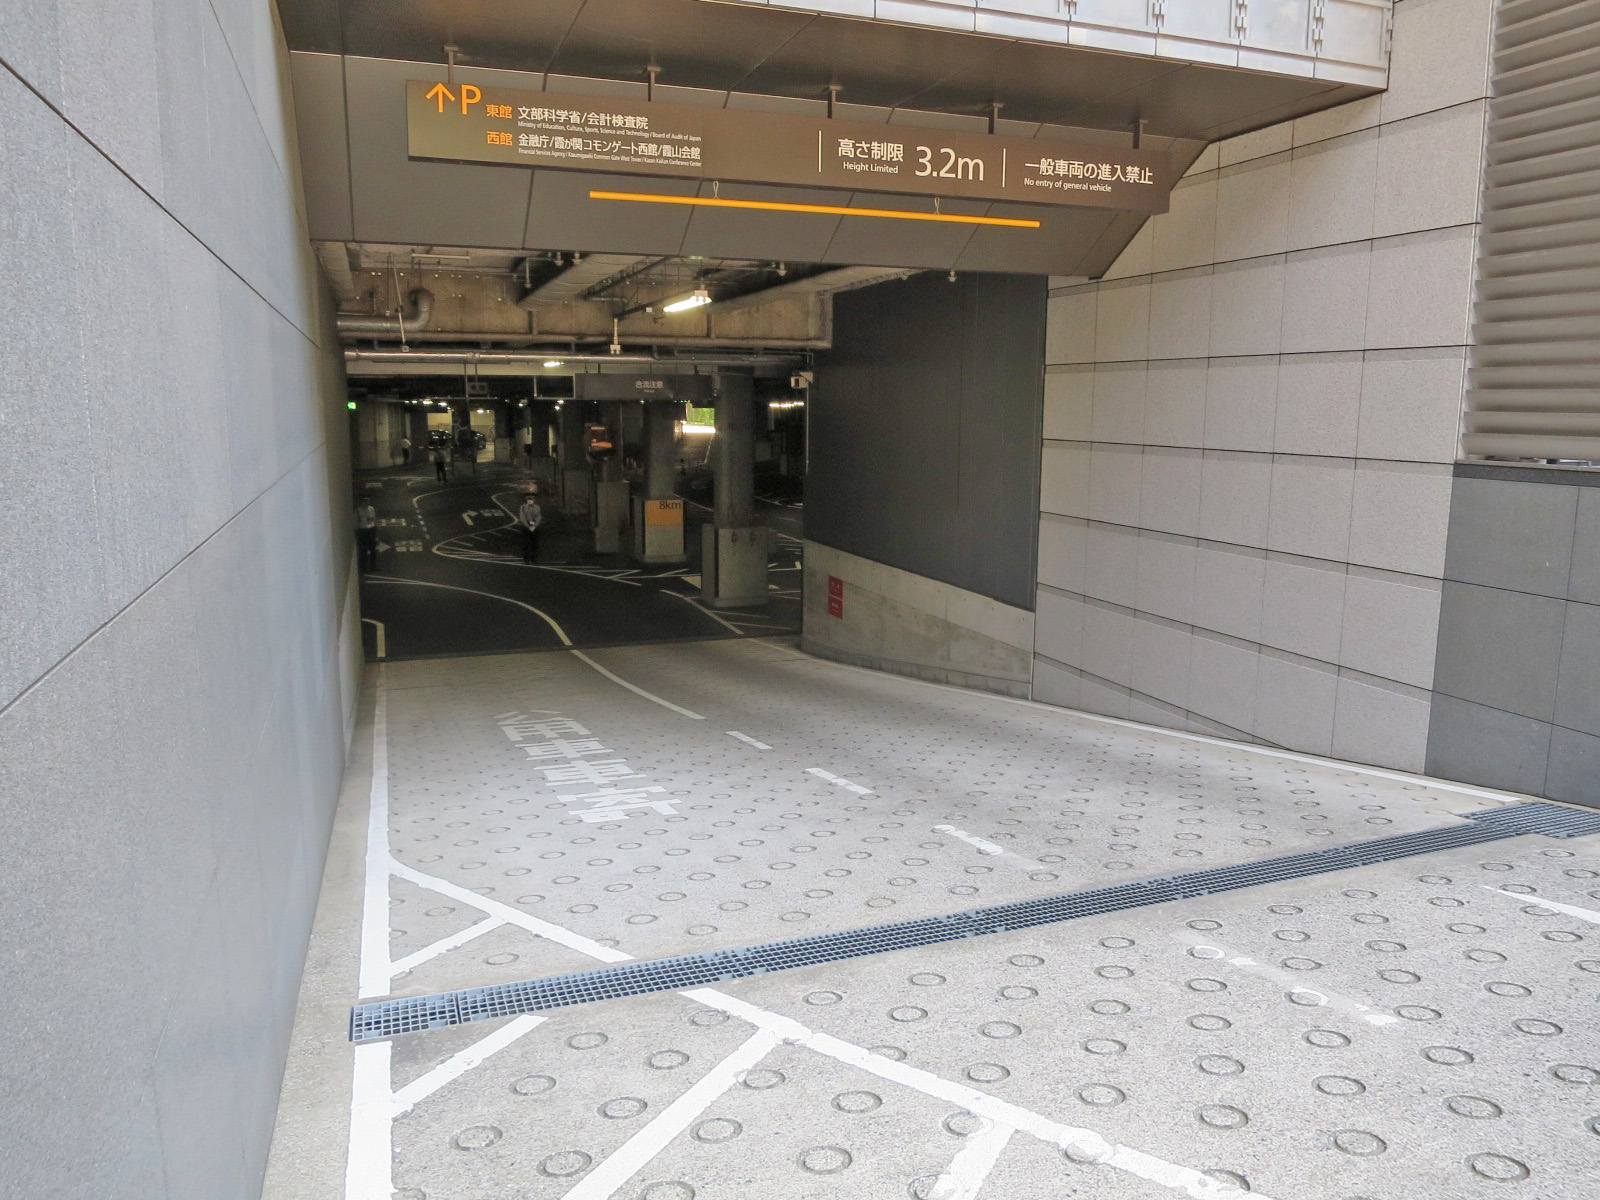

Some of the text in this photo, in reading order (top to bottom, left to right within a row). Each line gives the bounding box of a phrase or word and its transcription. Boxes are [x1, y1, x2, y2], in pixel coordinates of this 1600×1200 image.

[461, 85, 482, 115] P
[486, 104, 512, 119] 東館
[518, 106, 649, 130] 文部科学省/会計検査院
[486, 131, 513, 146] 西館
[518, 121, 536, 129] Ministry
[542, 123, 566, 131] Education,
[626, 130, 649, 138] Technology
[518, 133, 701, 160] 金融庁/霞が関コモンゲート西館/霞山会館
[838, 138, 904, 162] 高さ制限
[843, 161, 899, 174] Height Limited
[915, 145, 984, 181] 3.2m
[1025, 158, 1154, 185] 一般車両の進入禁止
[1024, 178, 1112, 192] No entry of general vehicle
[659, 500, 681, 510] 8km
